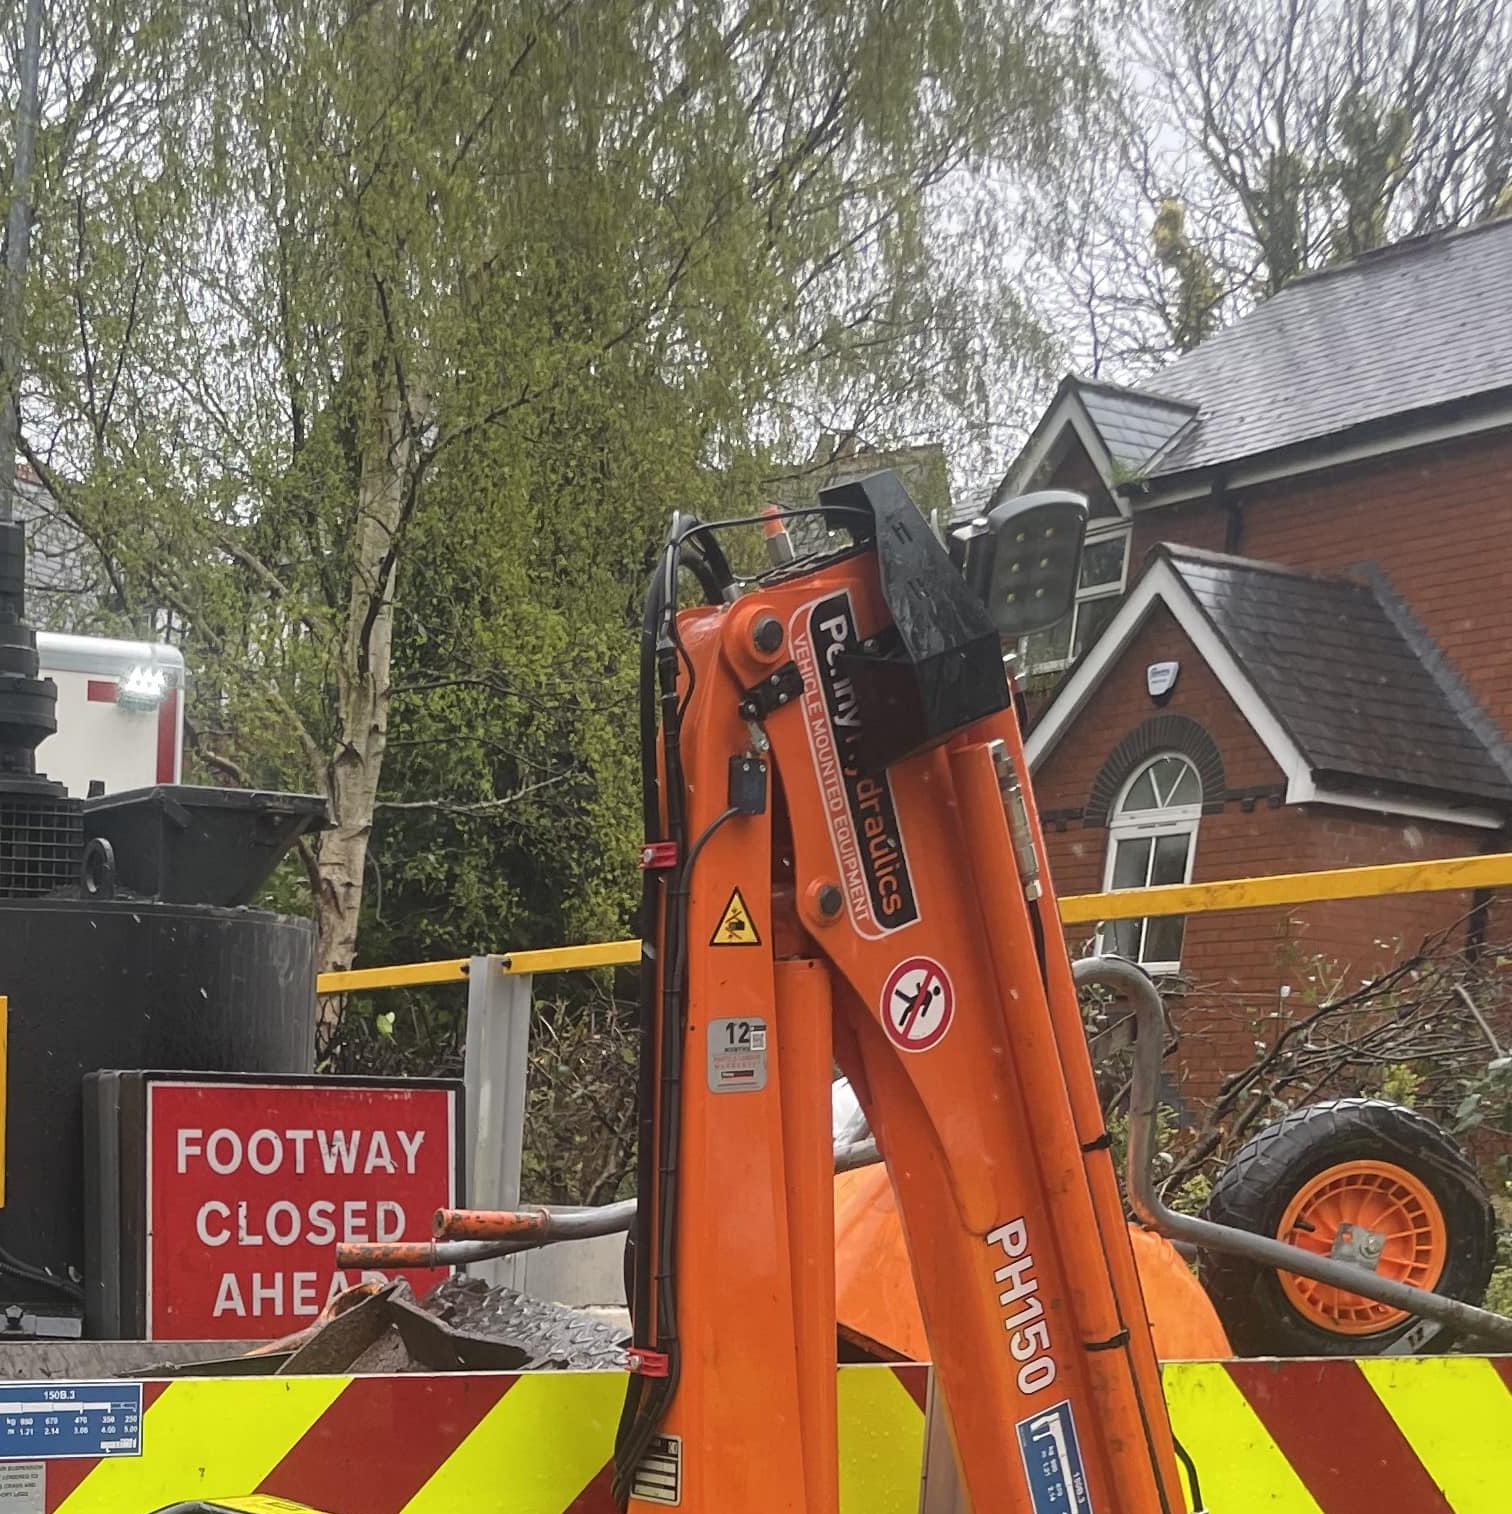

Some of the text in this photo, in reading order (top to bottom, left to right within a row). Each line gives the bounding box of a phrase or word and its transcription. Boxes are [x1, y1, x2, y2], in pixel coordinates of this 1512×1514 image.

[793, 632, 870, 921] VEHICLE MOUNTED EQUIPMENT
[726, 1022, 750, 1044] 12
[176, 1128, 426, 1175] FOOTWAY
[196, 1200, 406, 1247] CLOSED
[986, 1216, 1058, 1396] PH150
[43, 1390, 76, 1401] 150B.3
